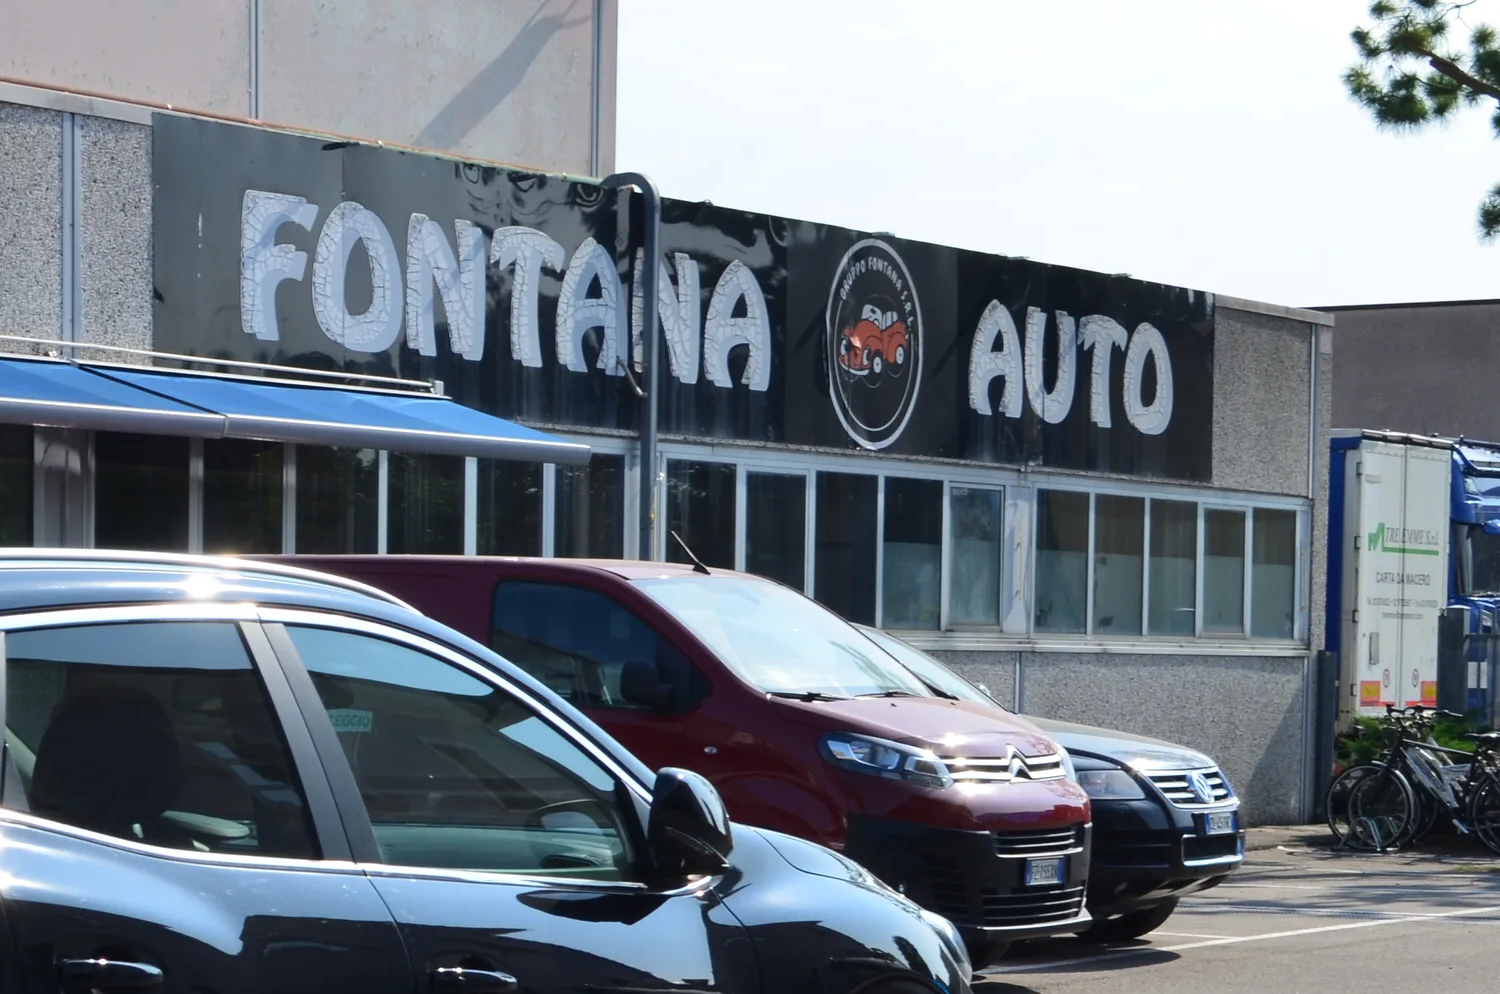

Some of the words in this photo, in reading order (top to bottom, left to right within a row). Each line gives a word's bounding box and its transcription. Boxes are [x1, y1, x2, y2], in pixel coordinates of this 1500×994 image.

[840, 260, 865, 300] GRUPPO
[868, 257, 902, 291] FONTANA
[241, 190, 771, 391] FONTANA
[969, 299, 1173, 435] AUTO
[1376, 572, 1395, 584] CARTA
[1406, 573, 1431, 586] MACERO
[329, 714, 370, 727] EGGIO
